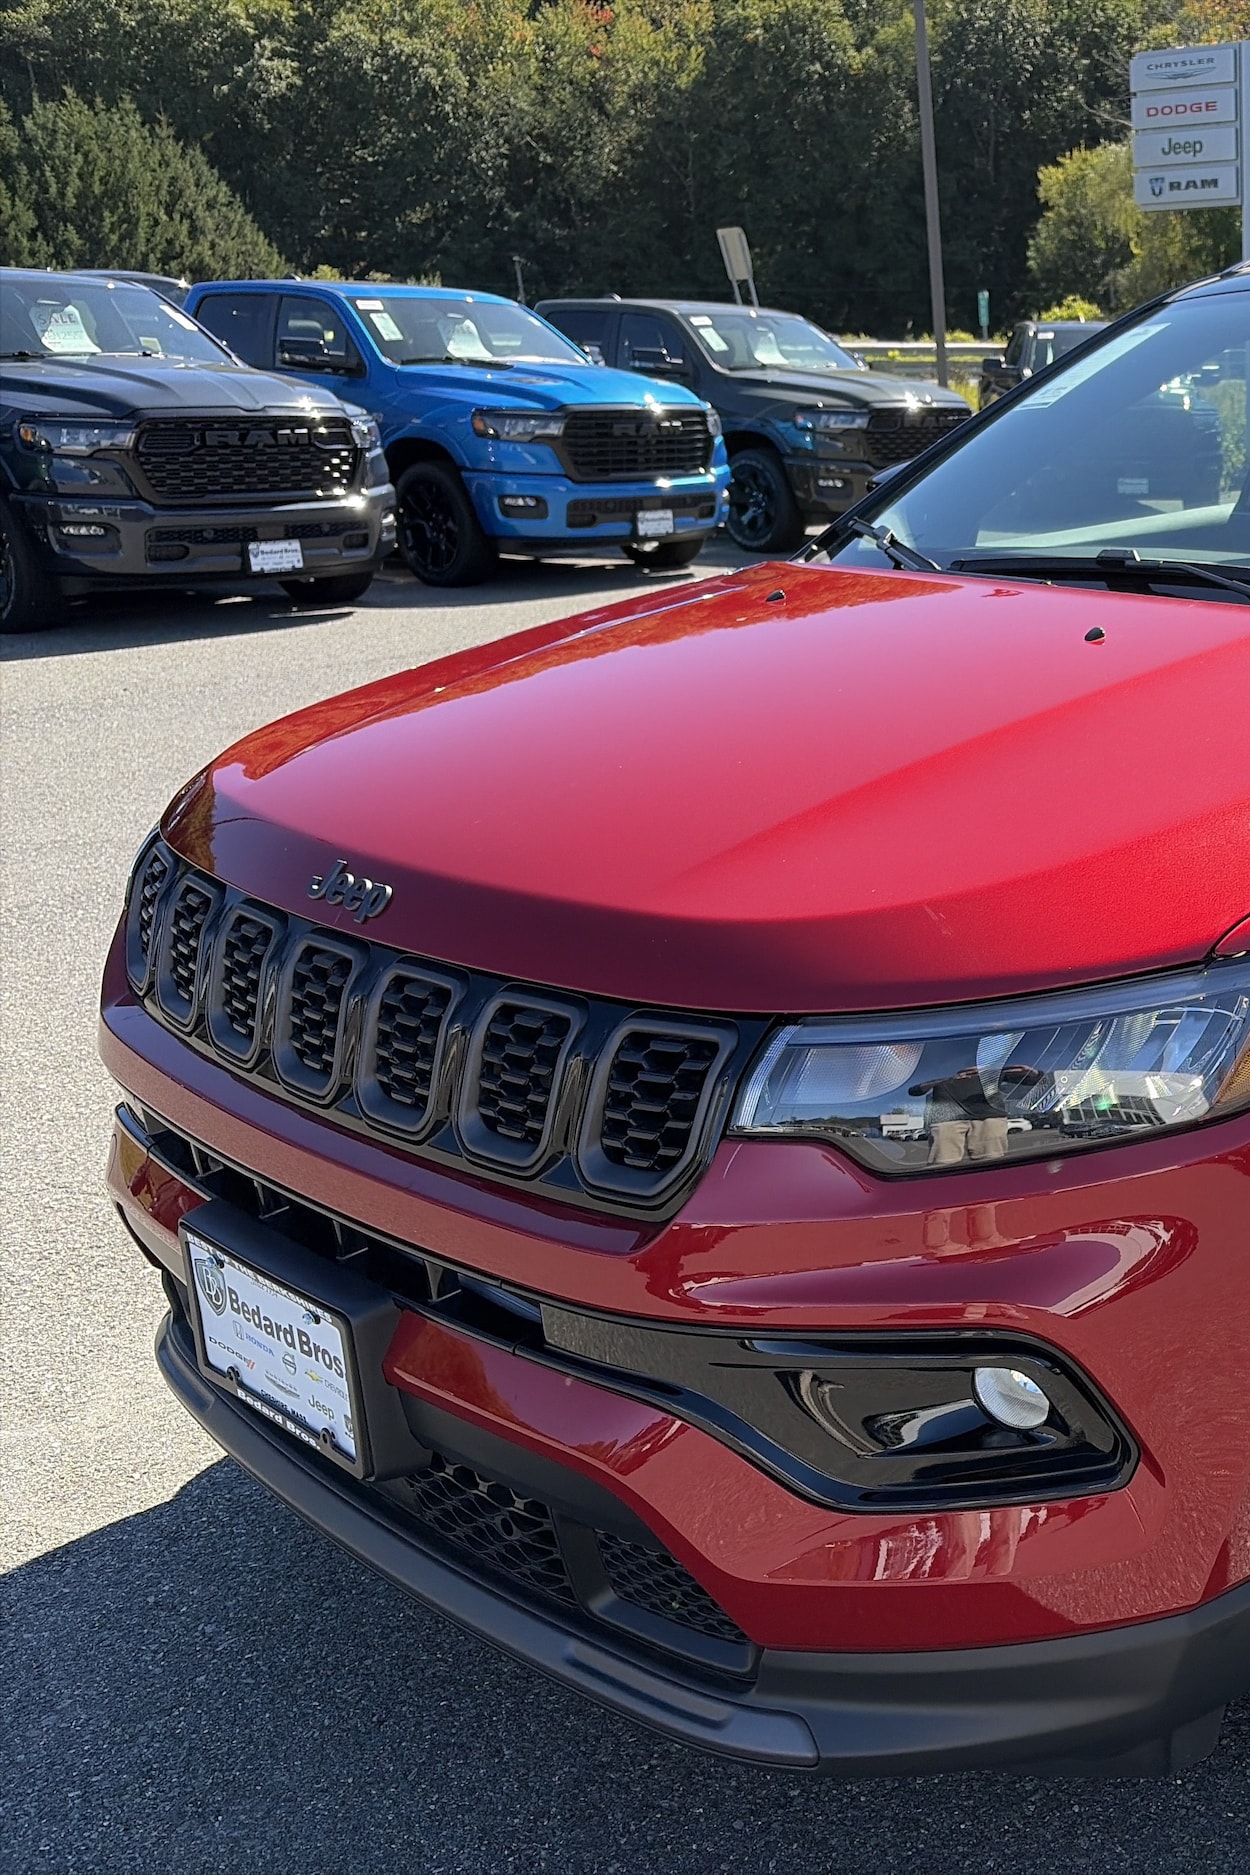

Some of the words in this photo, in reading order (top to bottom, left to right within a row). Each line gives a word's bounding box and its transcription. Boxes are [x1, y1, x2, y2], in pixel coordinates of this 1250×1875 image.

[1146, 57, 1215, 71] CHRYSLER
[1146, 101, 1218, 117] DODGE
[1161, 138, 1203, 157] Jeep
[1168, 178, 1219, 192] RAM
[205, 428, 309, 446] RAM
[307, 859, 393, 924] Jeep
[187, 1232, 213, 1254] BEST
[231, 1259, 256, 1279] THE
[228, 1286, 297, 1350] Bedard
[245, 1332, 275, 1357] HONDA
[237, 1388, 283, 1425] Bedard
[286, 1420, 321, 1450] Bros.
[308, 1394, 335, 1421] Jeep
